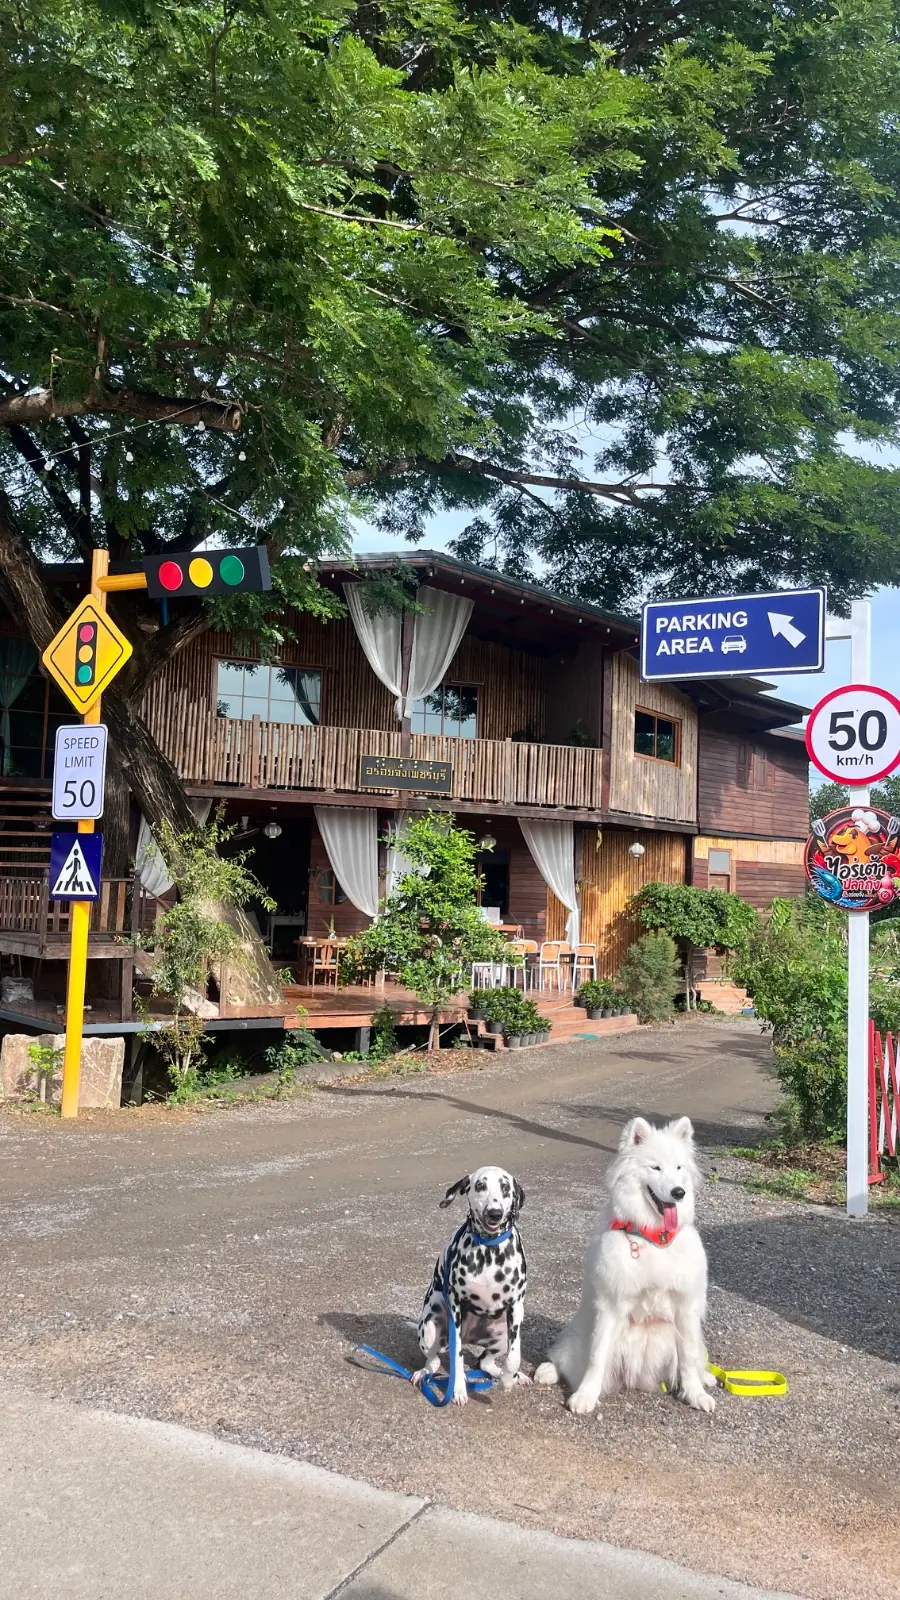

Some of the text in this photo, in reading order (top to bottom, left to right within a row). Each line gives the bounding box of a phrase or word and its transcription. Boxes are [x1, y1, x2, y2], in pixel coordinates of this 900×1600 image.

[656, 611, 748, 634] PARKING
[656, 637, 714, 656] AREA
[828, 709, 888, 752] 50
[63, 737, 99, 750] SPEED
[64, 755, 95, 768] LIMIT
[836, 753, 874, 766] km/h
[62, 779, 96, 808] 50
